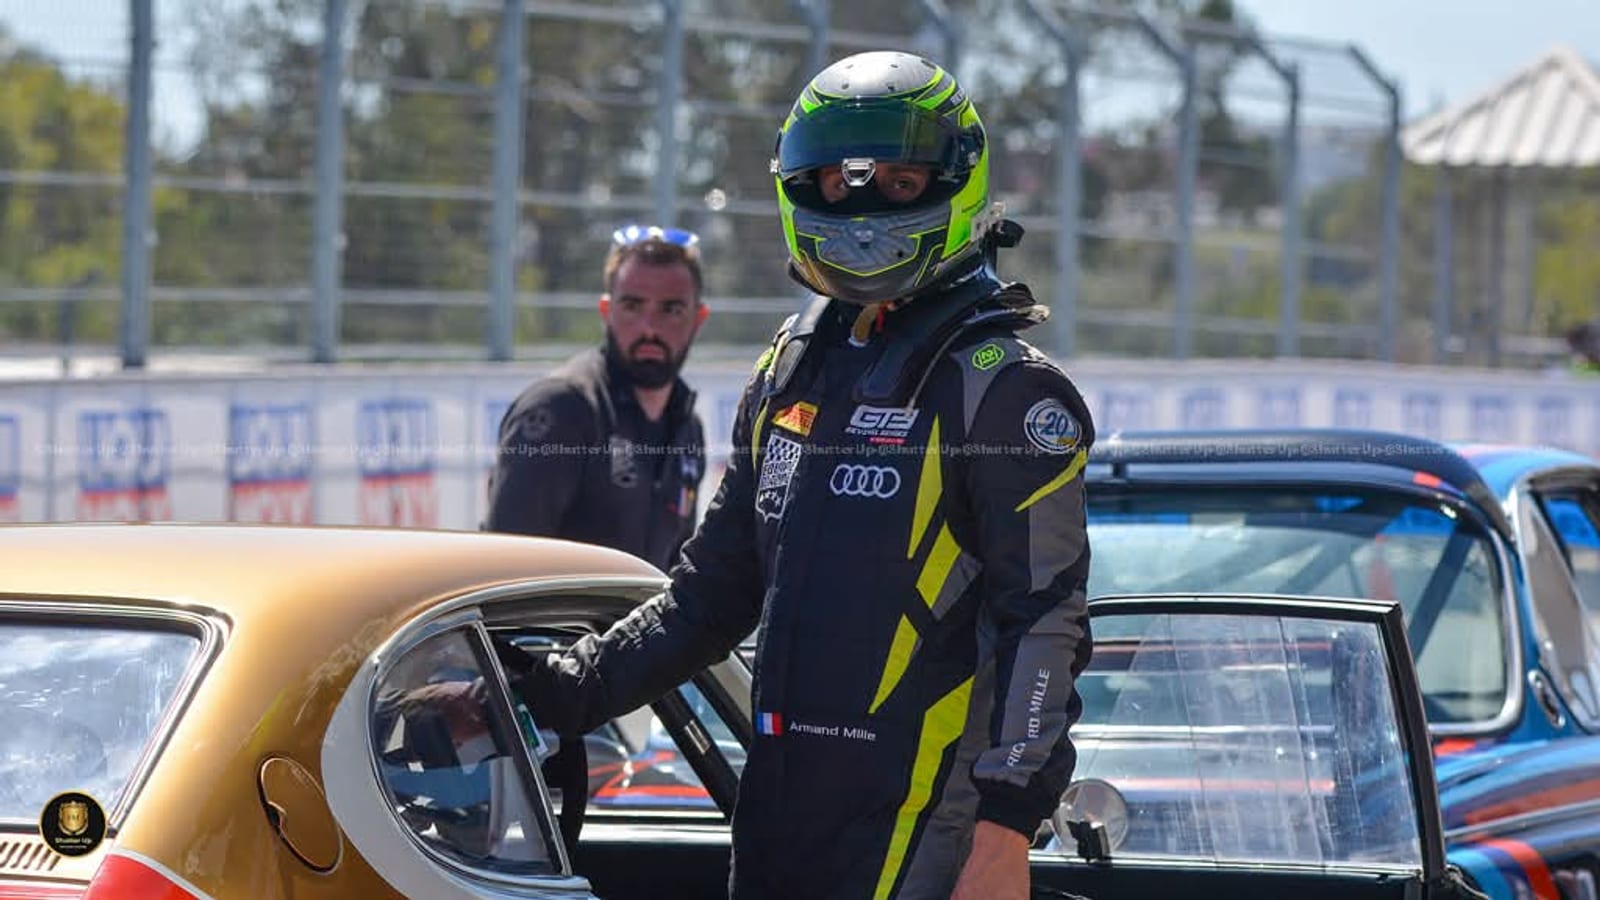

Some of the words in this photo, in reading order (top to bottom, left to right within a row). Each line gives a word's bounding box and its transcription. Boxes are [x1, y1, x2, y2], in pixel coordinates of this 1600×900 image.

[789, 720, 840, 736] Armand
[843, 727, 877, 741] Mille
[1007, 717, 1041, 767] RICRD
[1029, 667, 1050, 713] MILLE
